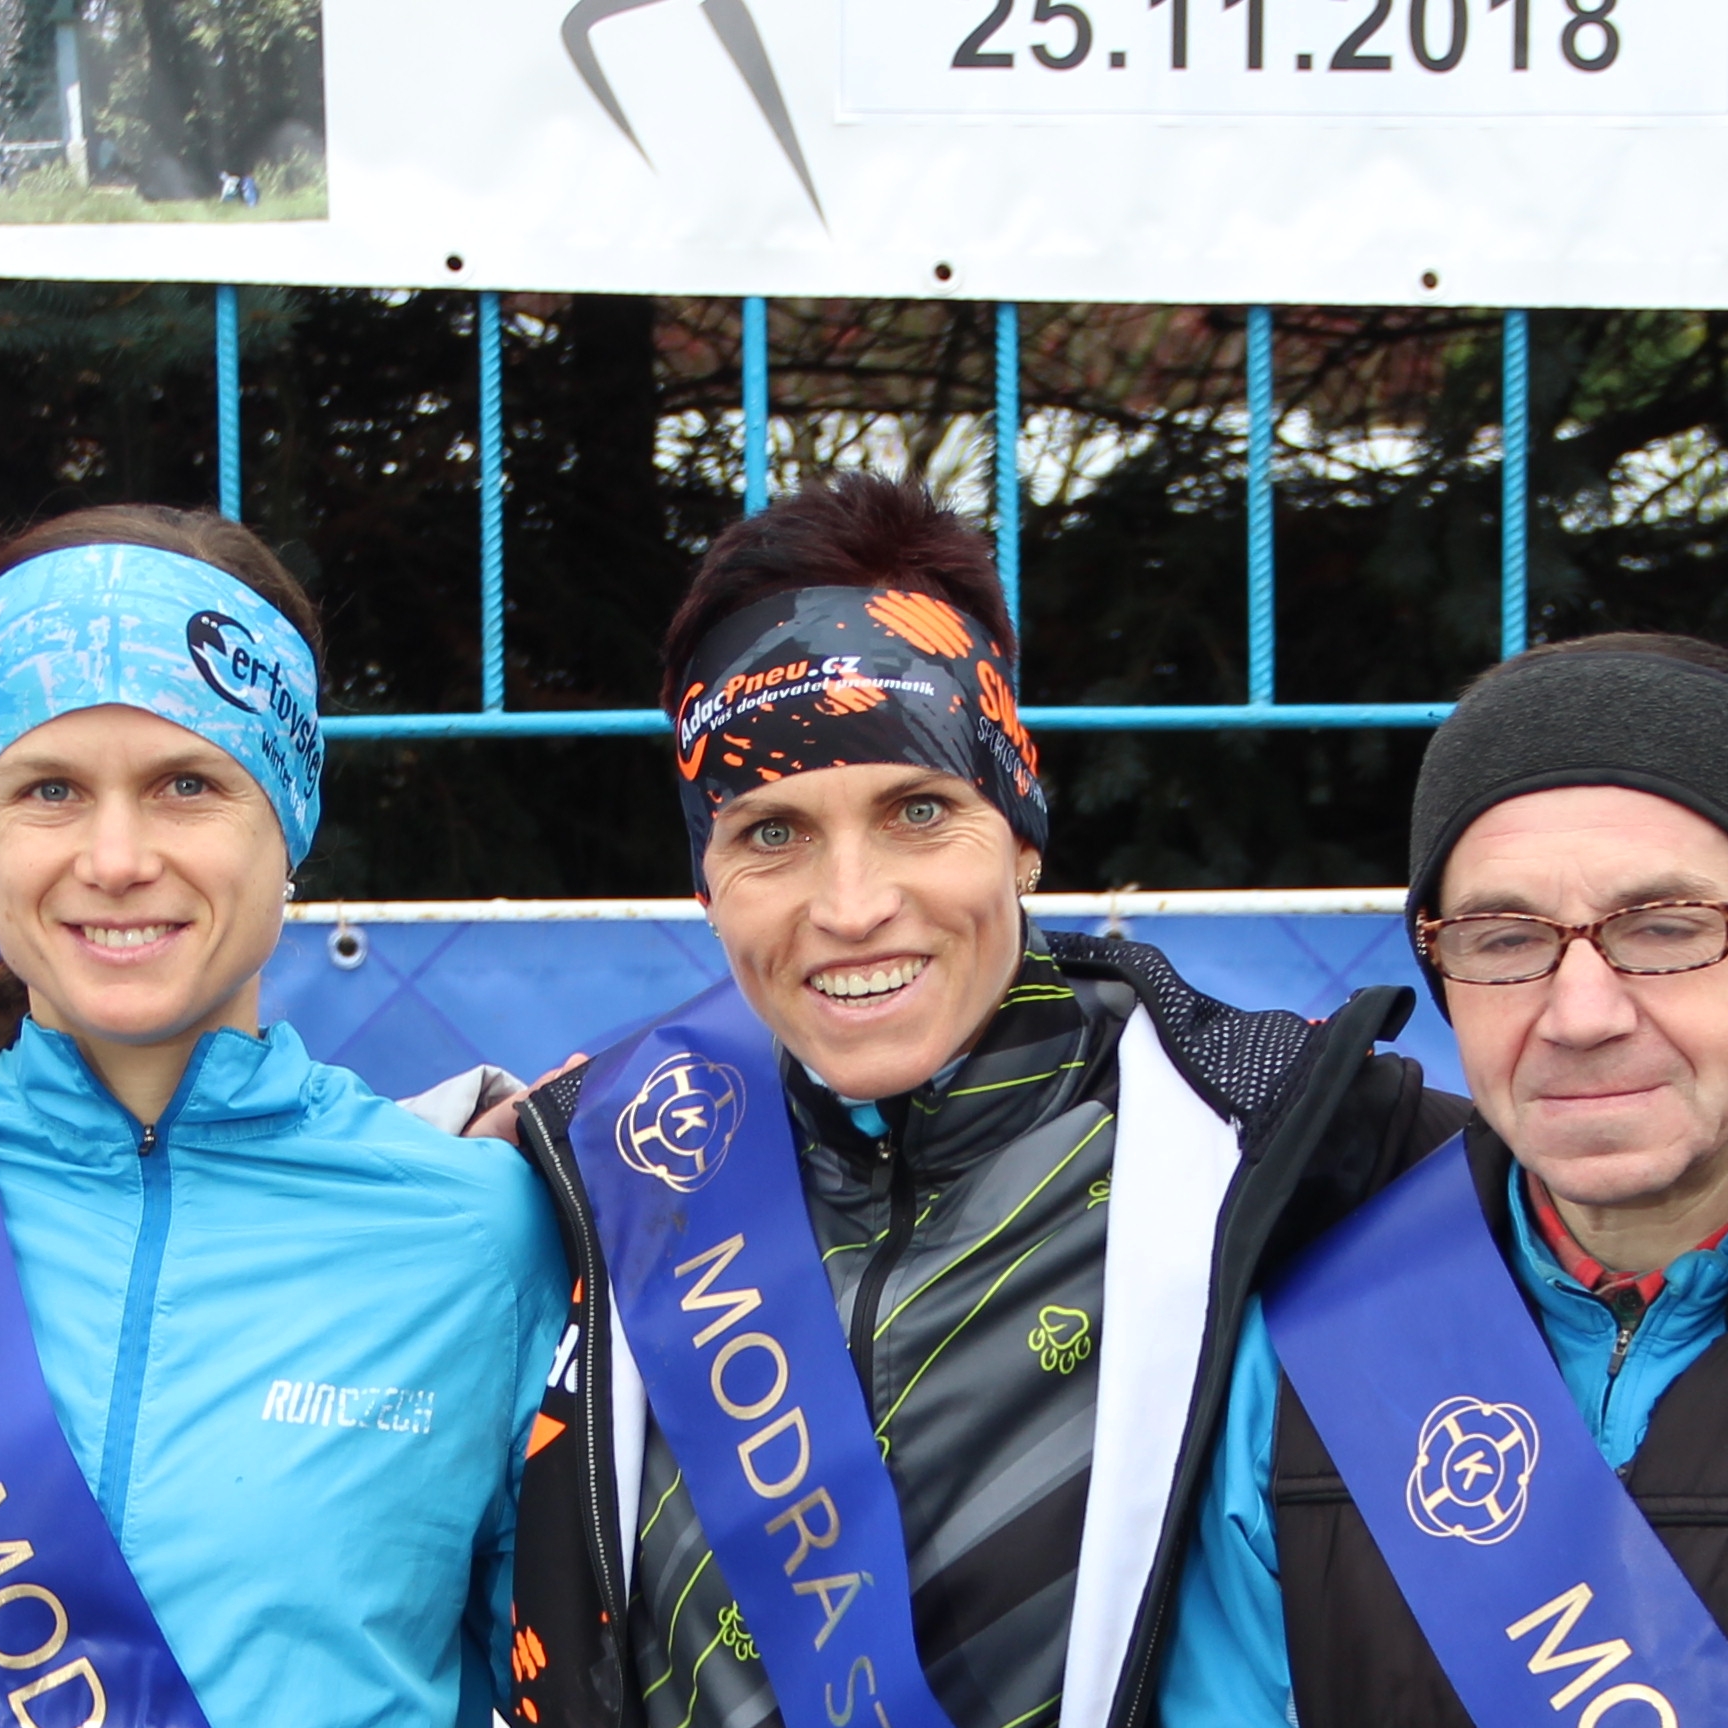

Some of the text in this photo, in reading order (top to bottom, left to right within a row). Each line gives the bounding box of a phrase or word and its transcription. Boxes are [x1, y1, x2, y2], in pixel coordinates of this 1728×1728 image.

[948, 0, 1623, 74] 25.11.2018
[736, 677, 830, 715] dodavatel
[834, 676, 936, 697] pneumatik
[673, 1232, 874, 1652] MODRÁ
